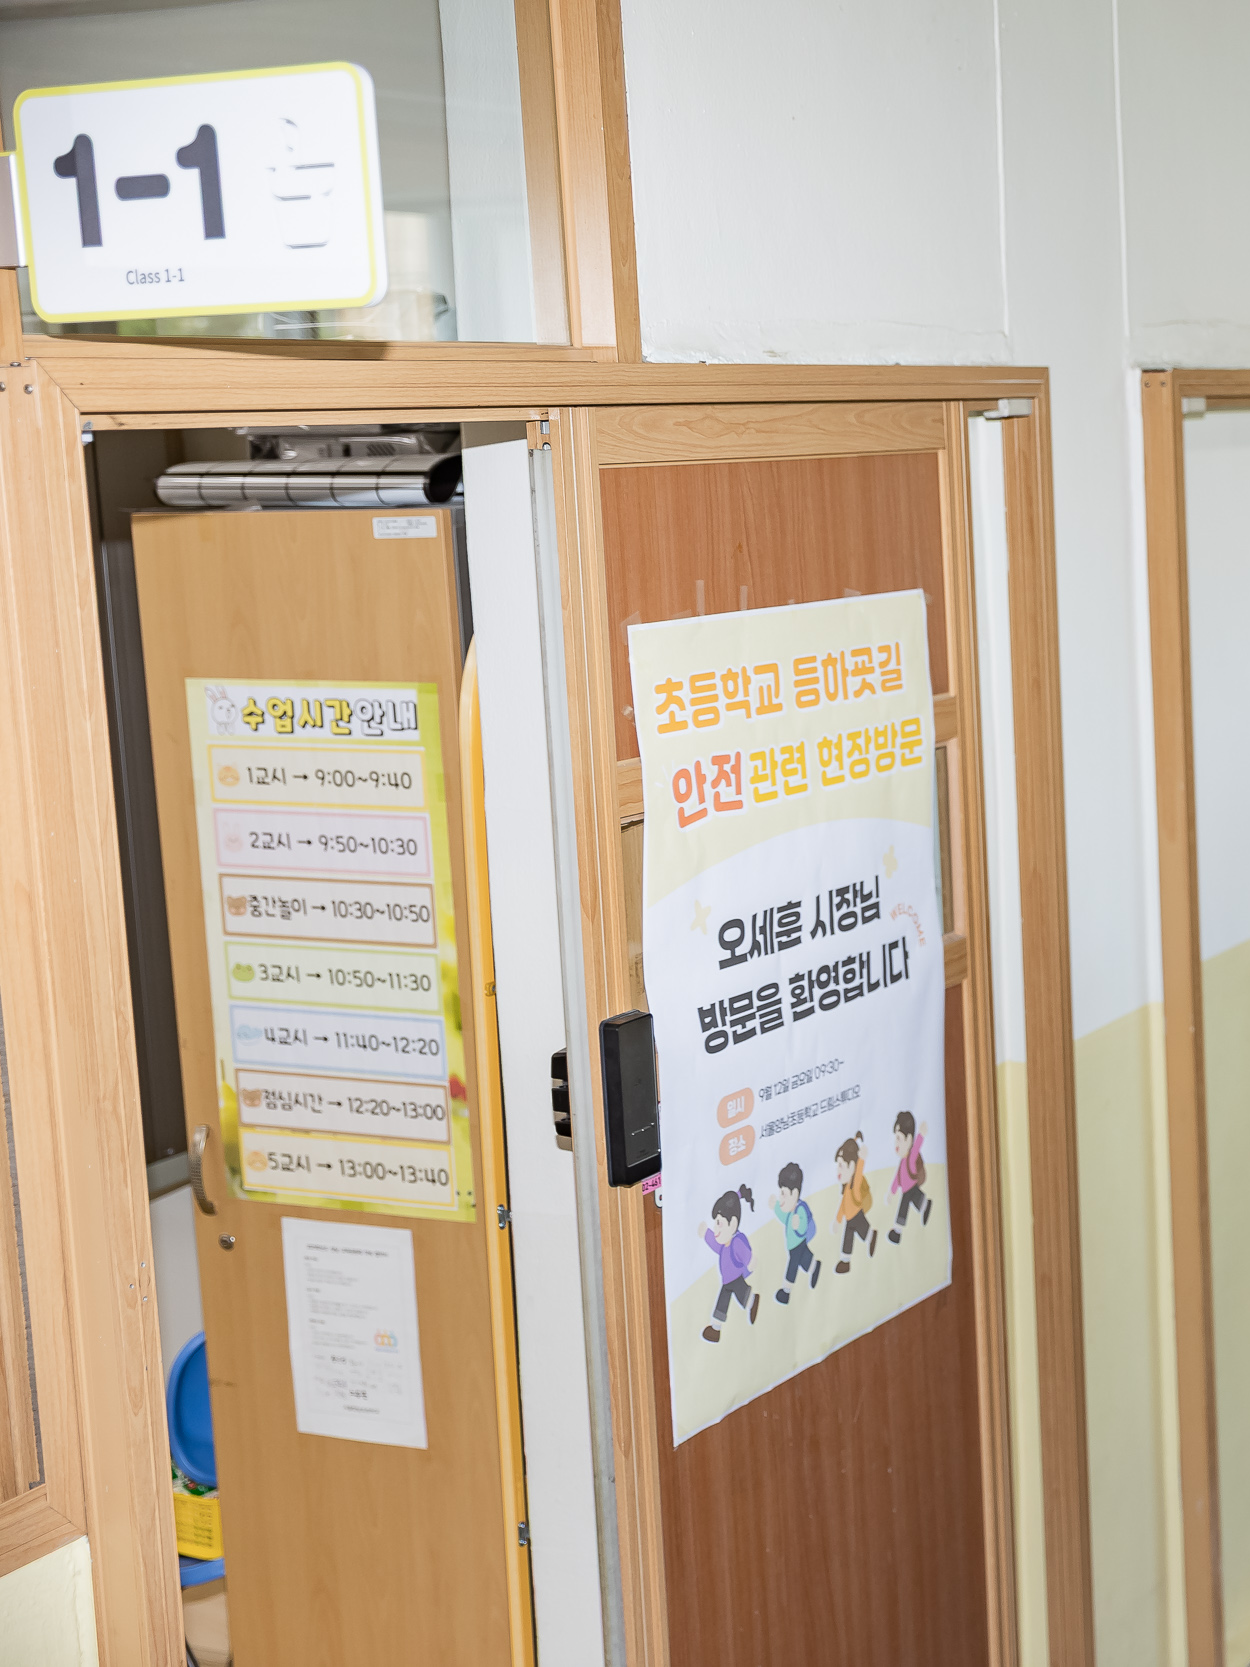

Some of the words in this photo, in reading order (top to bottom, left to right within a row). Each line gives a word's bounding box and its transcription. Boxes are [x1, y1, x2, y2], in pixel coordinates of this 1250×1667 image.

[53, 123, 227, 248] 1-1
[126, 269, 162, 286] Class
[164, 267, 186, 283] 1-1
[654, 662, 784, 735] 초등학교
[792, 641, 904, 710] 등하굣길
[816, 717, 924, 788] 현장방문
[246, 767, 287, 786] 1교시
[315, 769, 413, 790] 9:00~9:40
[249, 832, 292, 851] 2교시
[318, 835, 418, 856] 9:50~10:30
[249, 894, 308, 920] 중간놀이
[331, 900, 431, 923] 10:30~10:50
[717, 899, 803, 970] 오세훈
[809, 875, 882, 940] 시장님
[258, 963, 301, 983] 3교시
[327, 968, 432, 993] 10:50~11:30
[697, 982, 785, 1055] 방문을
[788, 936, 910, 1023] 환영합니다
[264, 1026, 308, 1047] 4교시
[335, 1032, 440, 1057] 11:40~12:20
[262, 1088, 323, 1115] 점심시간
[347, 1096, 446, 1122] 12:20~13:00
[267, 1151, 312, 1174] 5교시
[338, 1158, 449, 1187] 13:00~13:40
